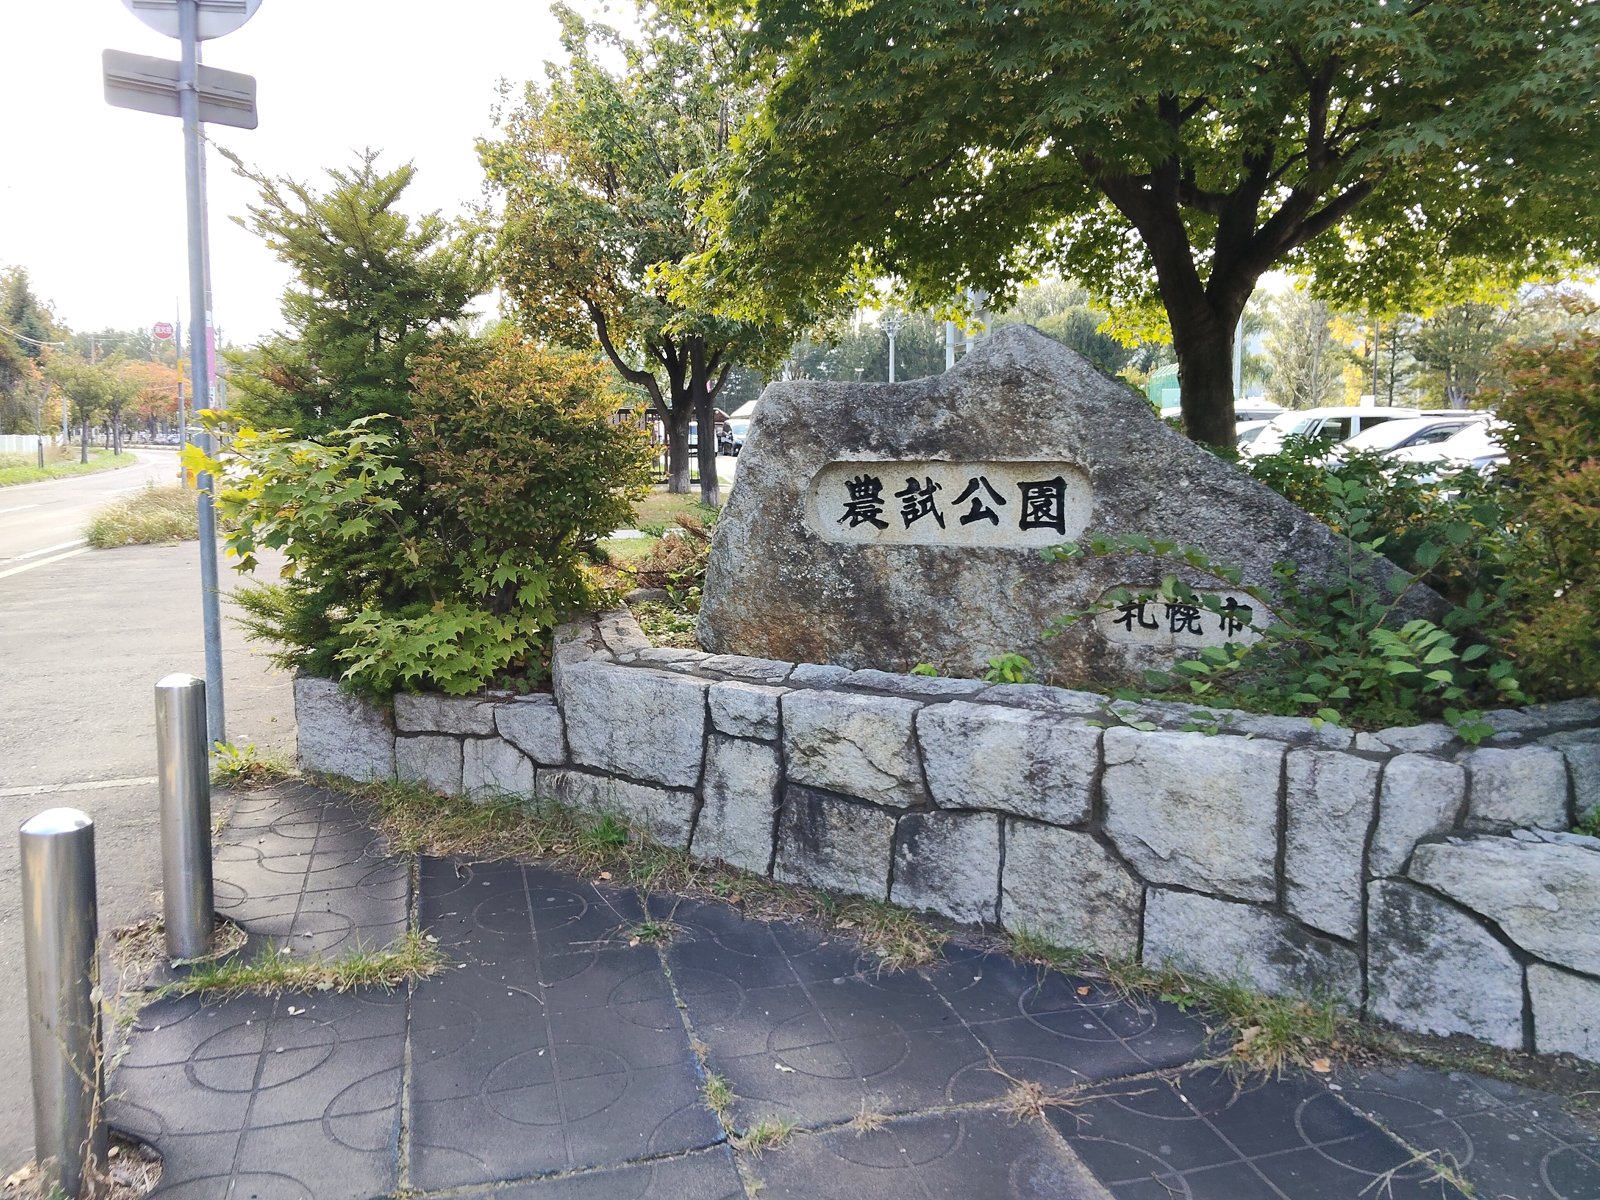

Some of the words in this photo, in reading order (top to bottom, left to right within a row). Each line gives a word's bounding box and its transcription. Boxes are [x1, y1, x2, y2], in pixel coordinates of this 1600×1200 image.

[837, 473, 1067, 535] 農試公園
[1113, 596, 1252, 637] 札幌市
